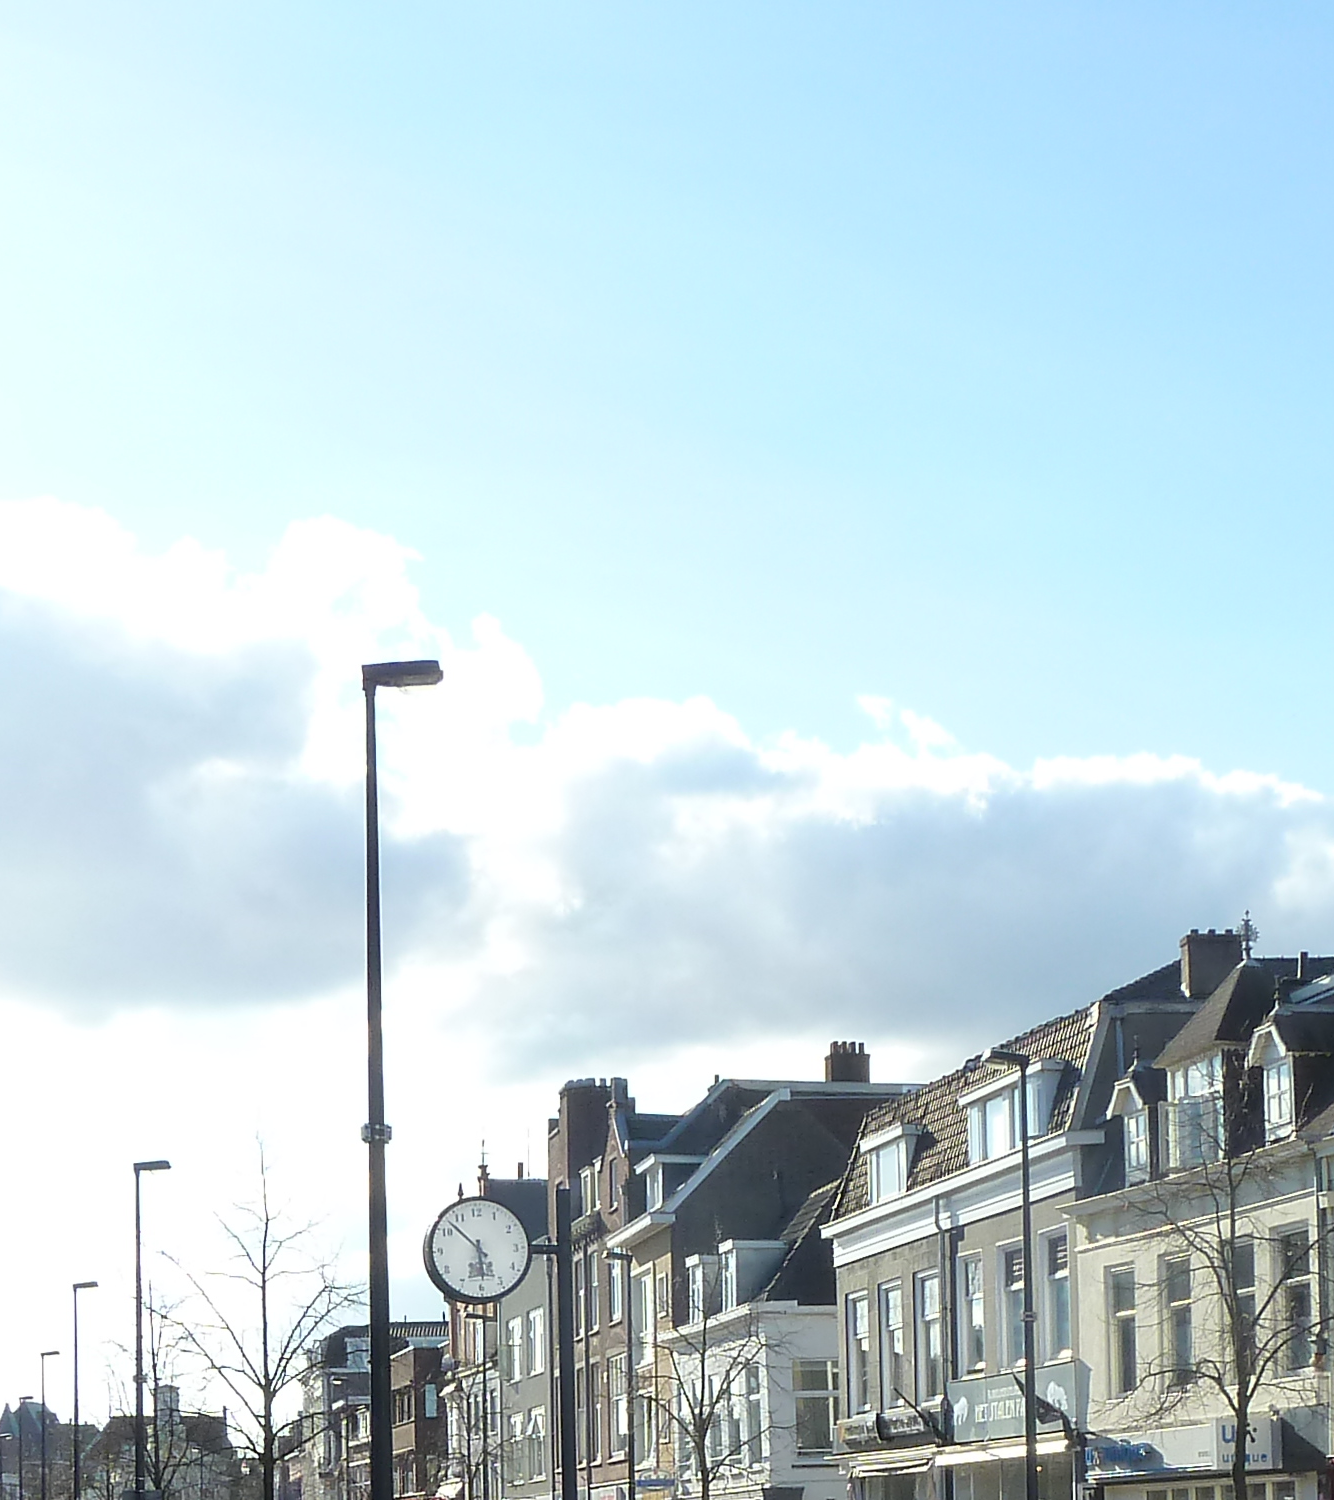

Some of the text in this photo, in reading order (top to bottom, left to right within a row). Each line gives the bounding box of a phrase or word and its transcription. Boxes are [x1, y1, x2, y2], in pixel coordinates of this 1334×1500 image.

[471, 1207, 482, 1218] 12
[492, 1211, 496, 1221] 1
[455, 1213, 465, 1223] 11
[442, 1228, 453, 1237] 10
[505, 1225, 511, 1234] 2
[437, 1247, 444, 1256] 9
[513, 1243, 519, 1253] 3
[478, 1283, 485, 1292] 6
